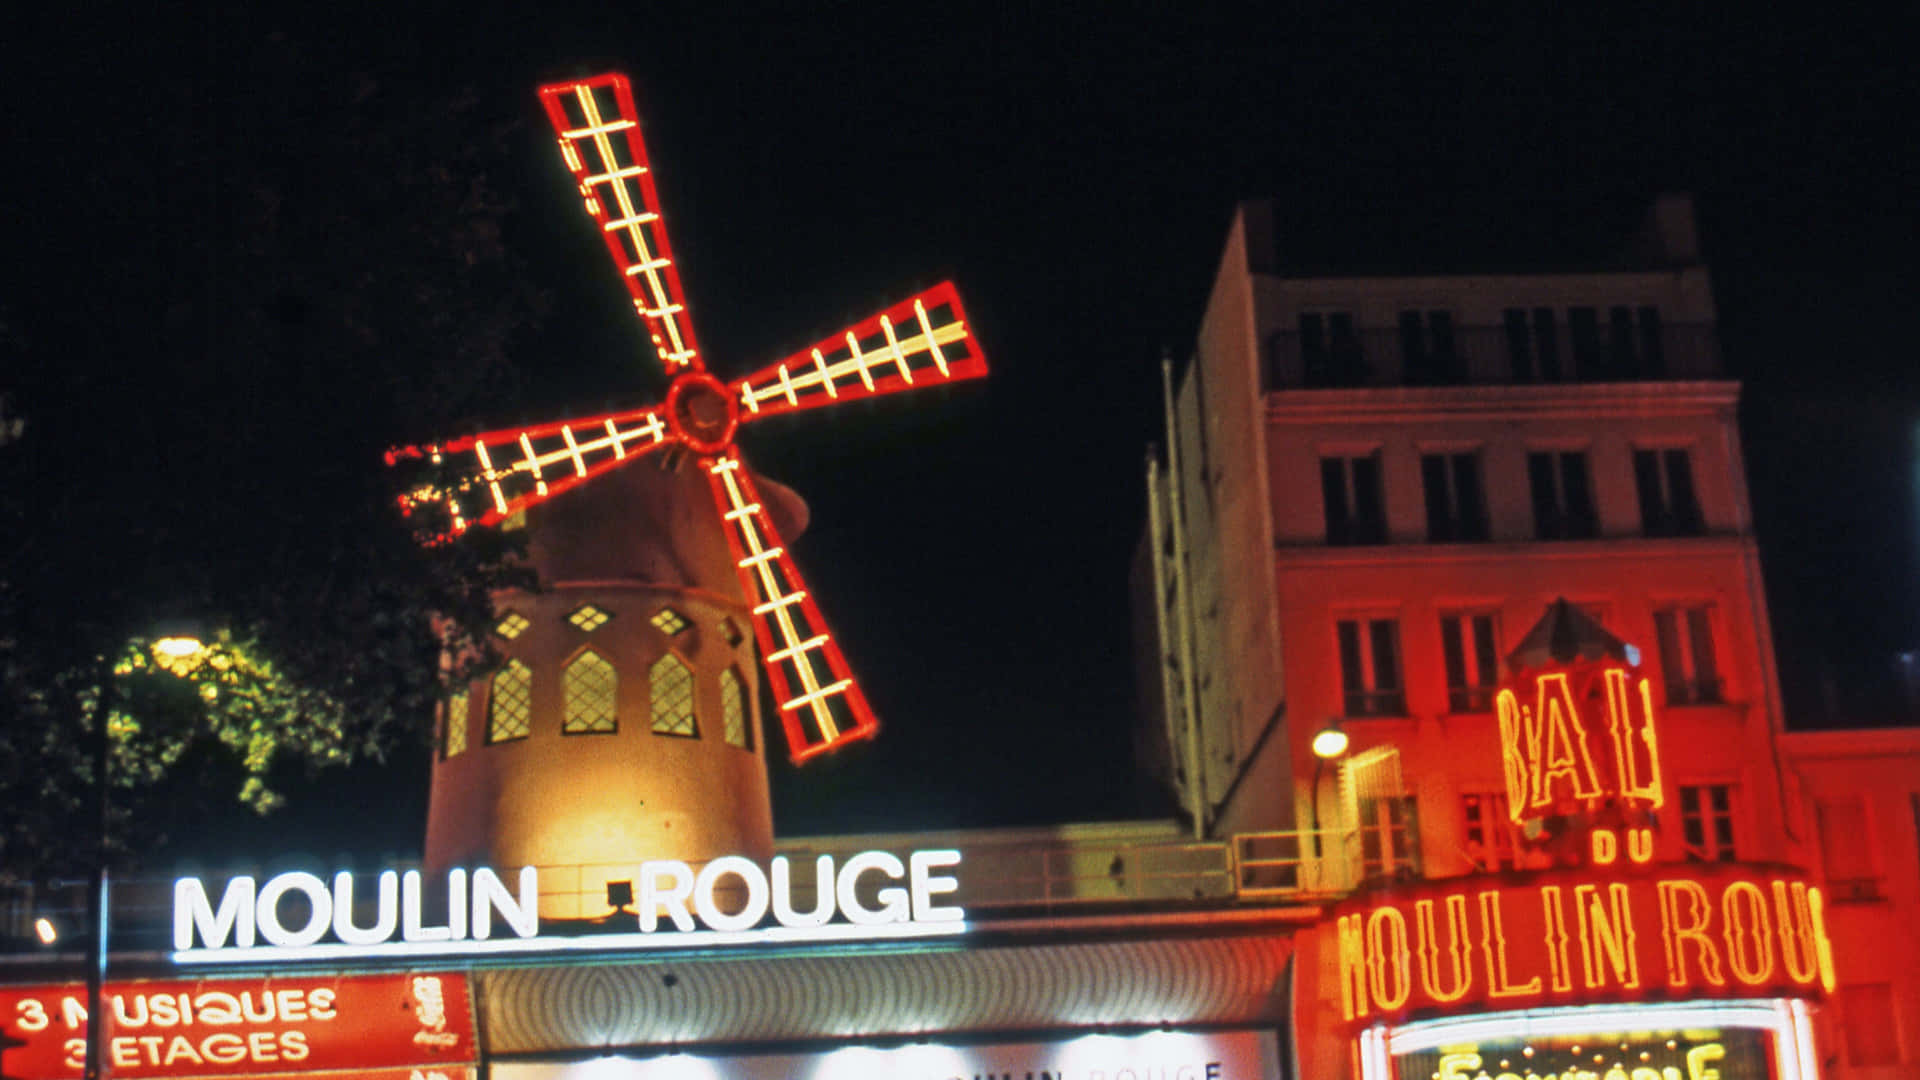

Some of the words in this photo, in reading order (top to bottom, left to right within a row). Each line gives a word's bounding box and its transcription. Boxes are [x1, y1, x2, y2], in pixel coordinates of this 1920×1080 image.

[1497, 669, 1664, 825] BAL
[1592, 829, 1653, 864] DU
[174, 866, 538, 950] MOULIN
[637, 850, 964, 933] ROUGE
[1337, 884, 1638, 1021] MOULIN
[1658, 880, 1835, 993] ROU
[16, 999, 49, 1031] 3
[111, 1031, 310, 1067] ETAGES
